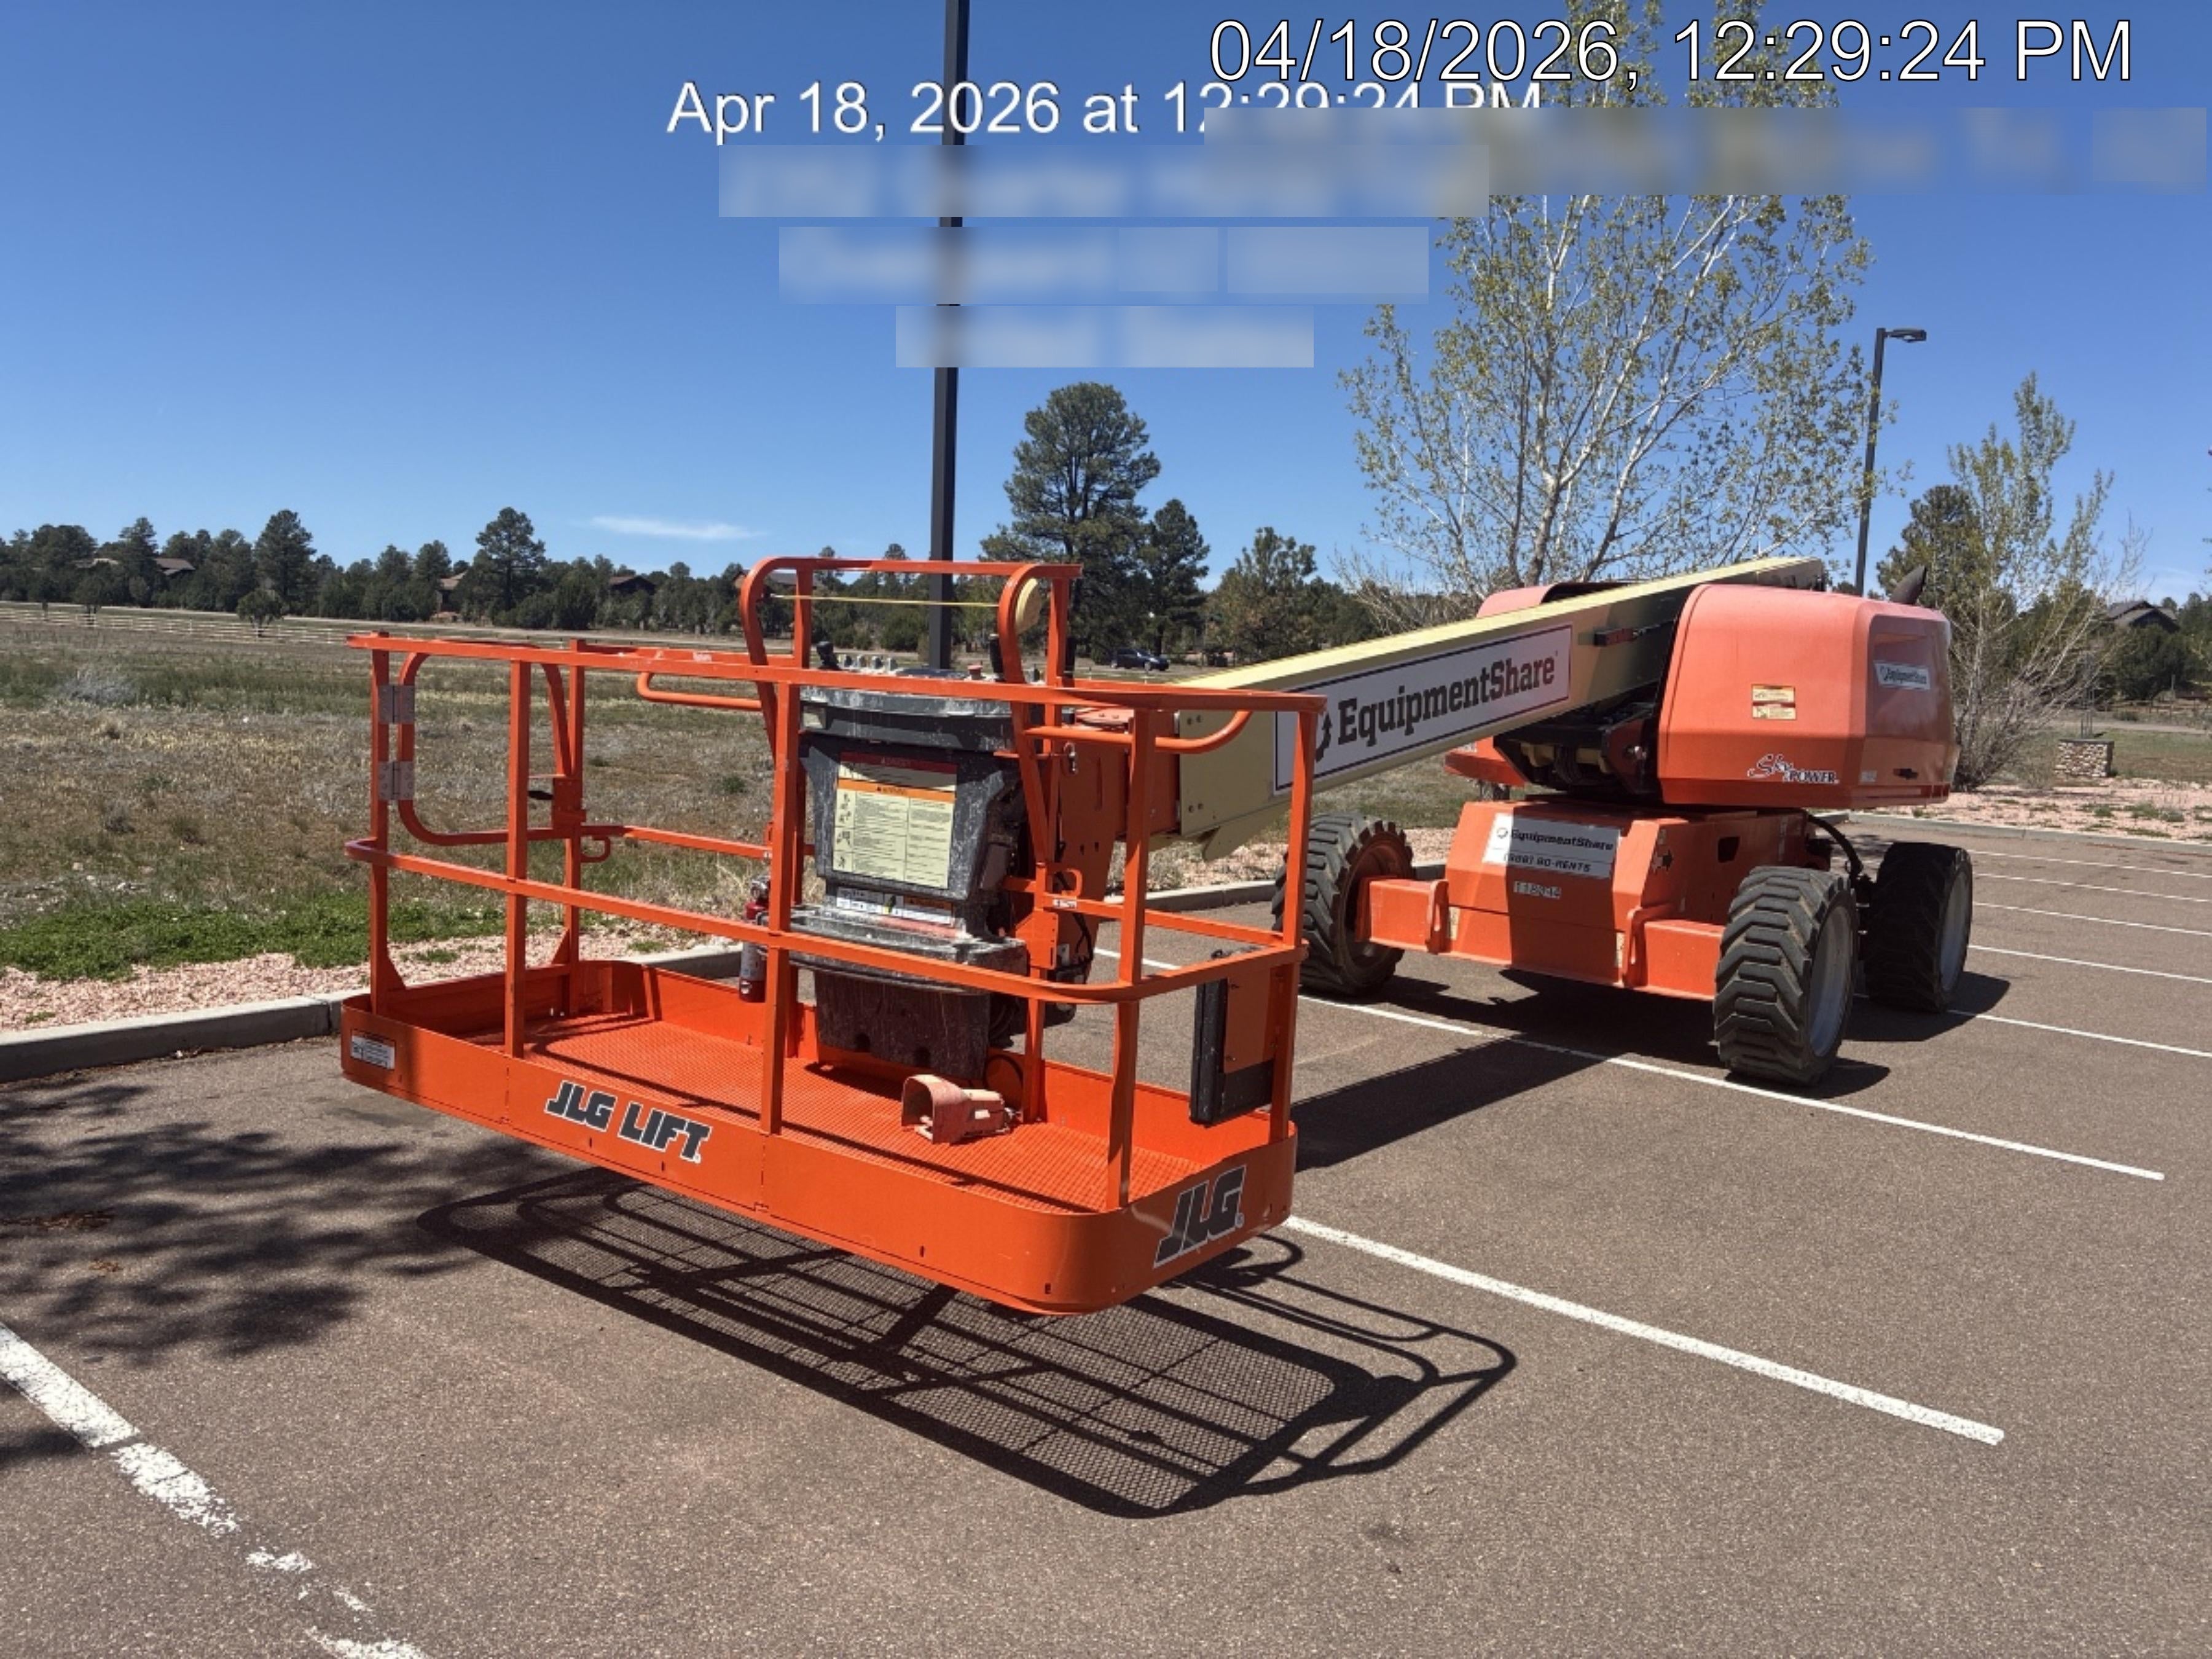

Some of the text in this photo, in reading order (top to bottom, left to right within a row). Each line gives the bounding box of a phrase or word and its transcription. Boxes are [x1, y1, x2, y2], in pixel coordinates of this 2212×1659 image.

[1338, 654, 1555, 748] EquipmentShare
[1512, 830, 1614, 850] EquipmentShare
[545, 1080, 713, 1163] JLG LIFT
[1153, 1165, 1247, 1268] JLG
